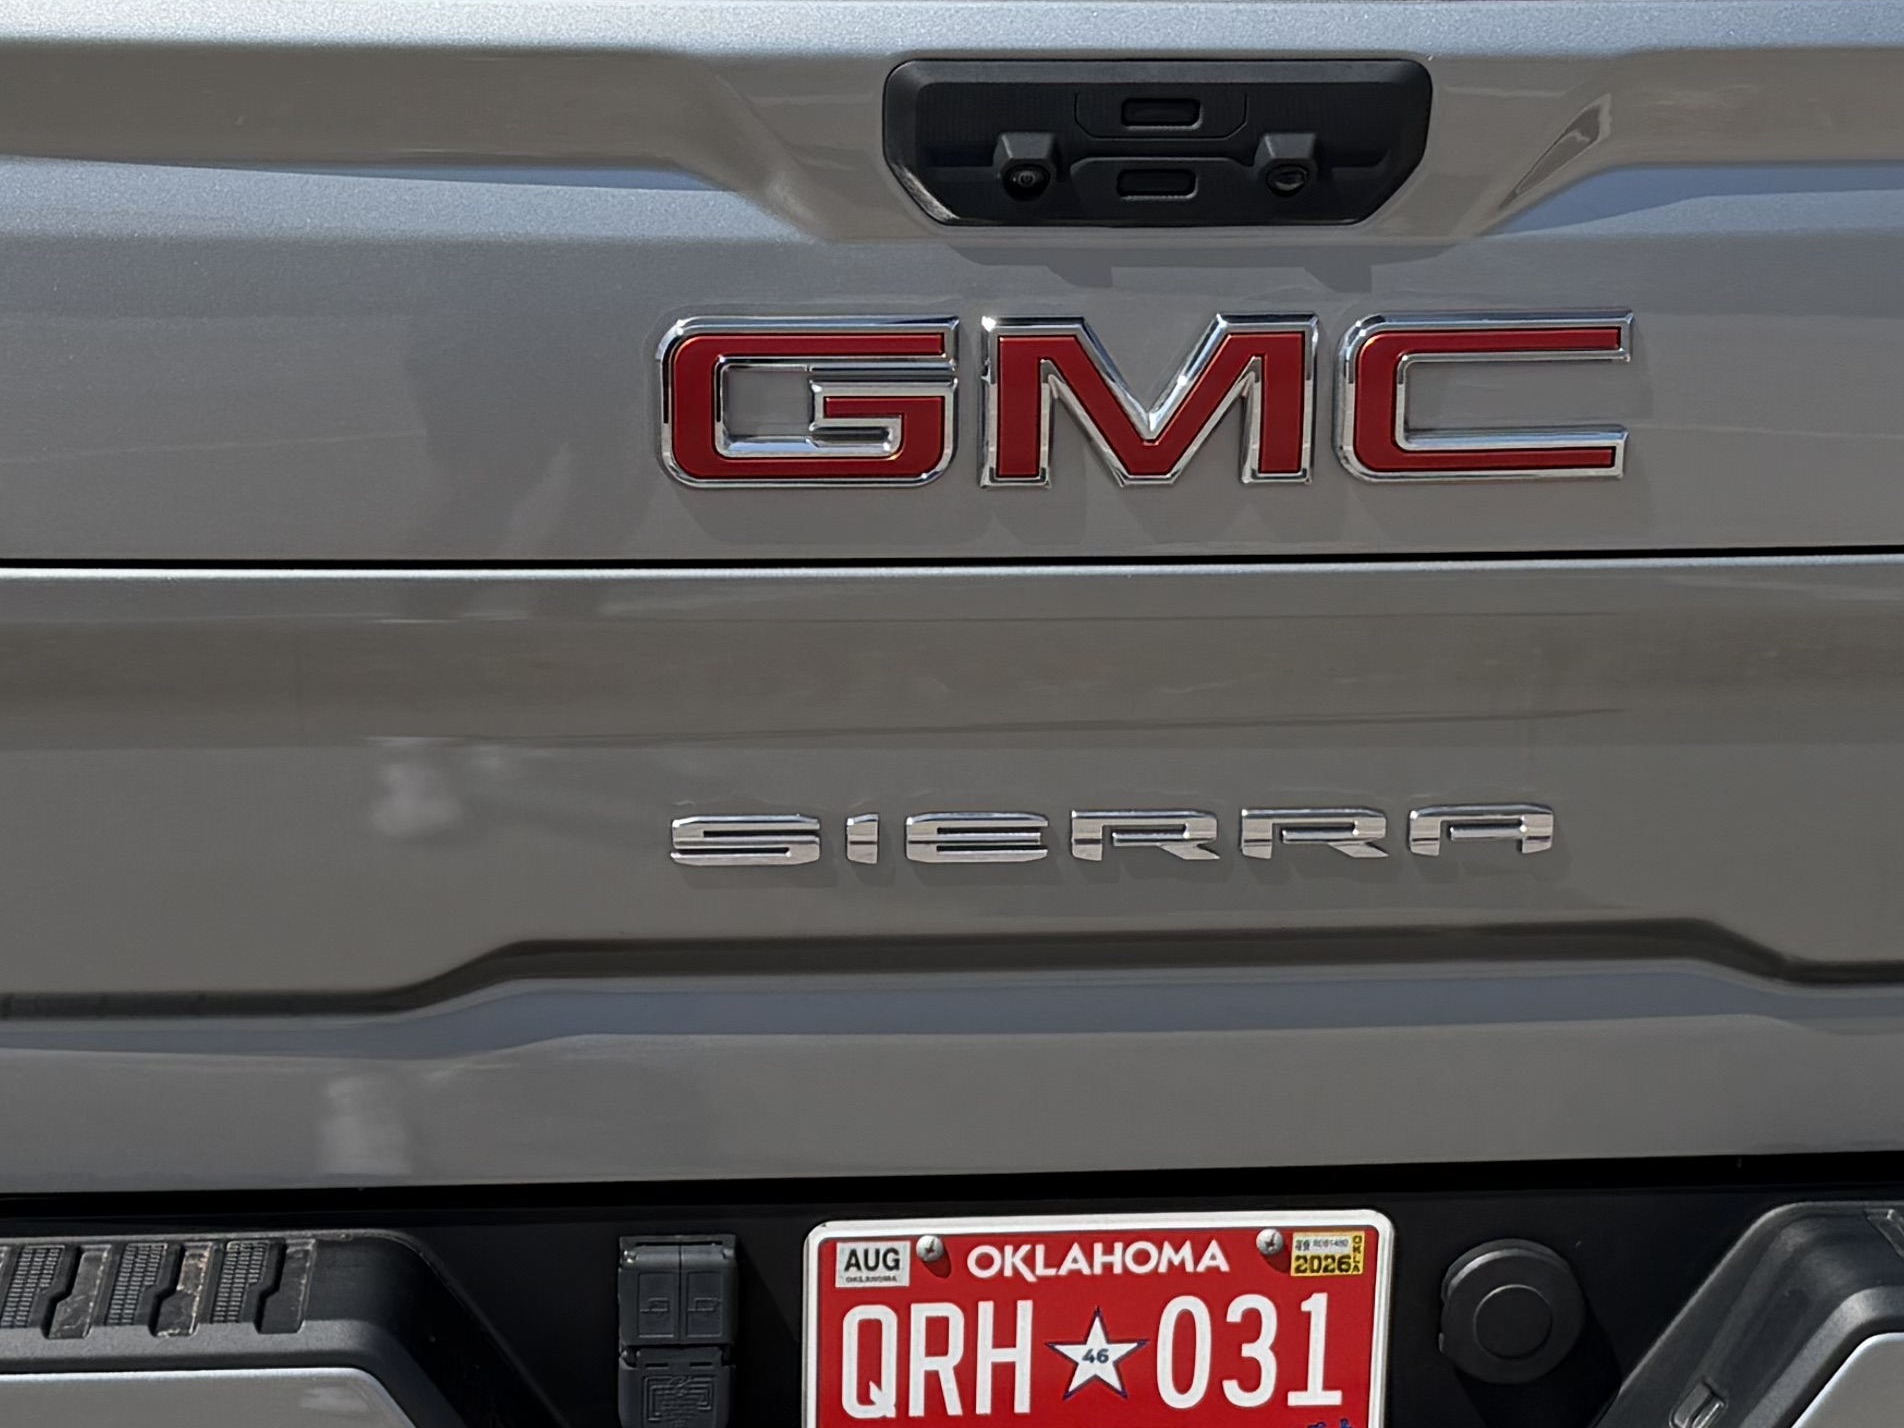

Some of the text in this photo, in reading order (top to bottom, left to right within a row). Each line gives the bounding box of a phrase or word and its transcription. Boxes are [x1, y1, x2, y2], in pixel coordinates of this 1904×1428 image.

[656, 312, 1634, 488] GMC
[670, 804, 1555, 865] SIERRA
[844, 1247, 900, 1272] AUG
[966, 1240, 1229, 1282] OKLAHOMA
[1295, 1254, 1352, 1274] 2026
[842, 1301, 1033, 1419] QRH
[1156, 1292, 1343, 1410] 031
[1082, 1348, 1109, 1364] 46
